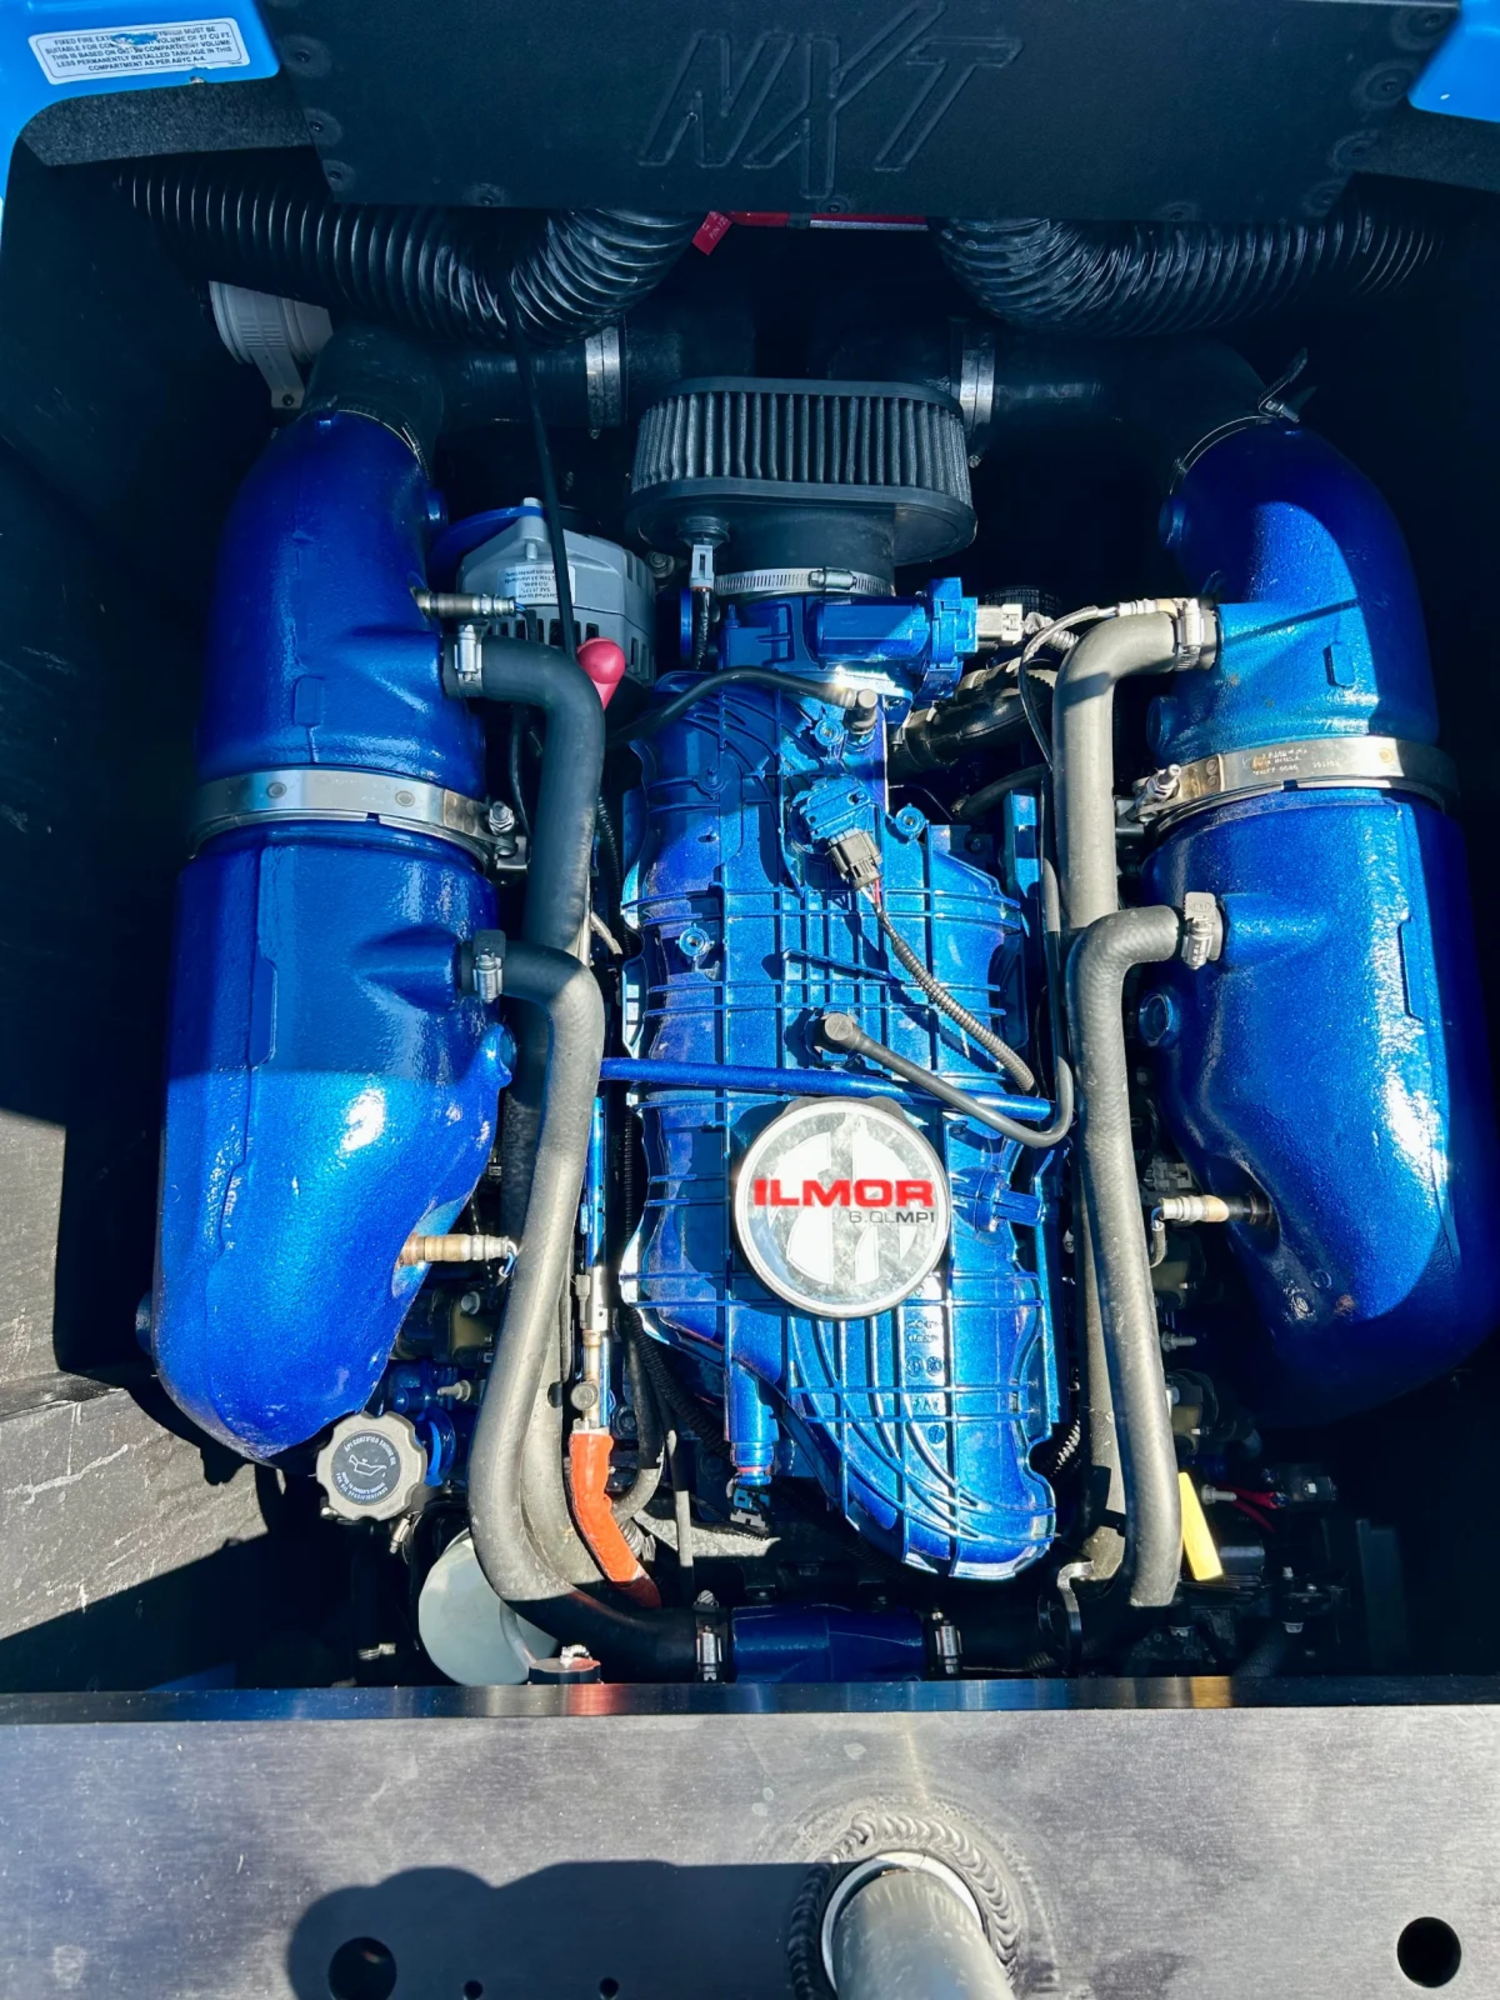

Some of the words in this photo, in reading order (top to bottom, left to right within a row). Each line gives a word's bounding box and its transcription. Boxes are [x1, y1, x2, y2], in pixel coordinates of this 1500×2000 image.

[45, 45, 80, 54] SUITABLE
[155, 36, 186, 44] VOLUME
[77, 55, 129, 65] PERMANENTLY
[131, 52, 170, 60] INSTALLED
[88, 61, 143, 71] COMPARTMENT
[637, 0, 1023, 199] NXT
[753, 1179, 935, 1208] ILMOR
